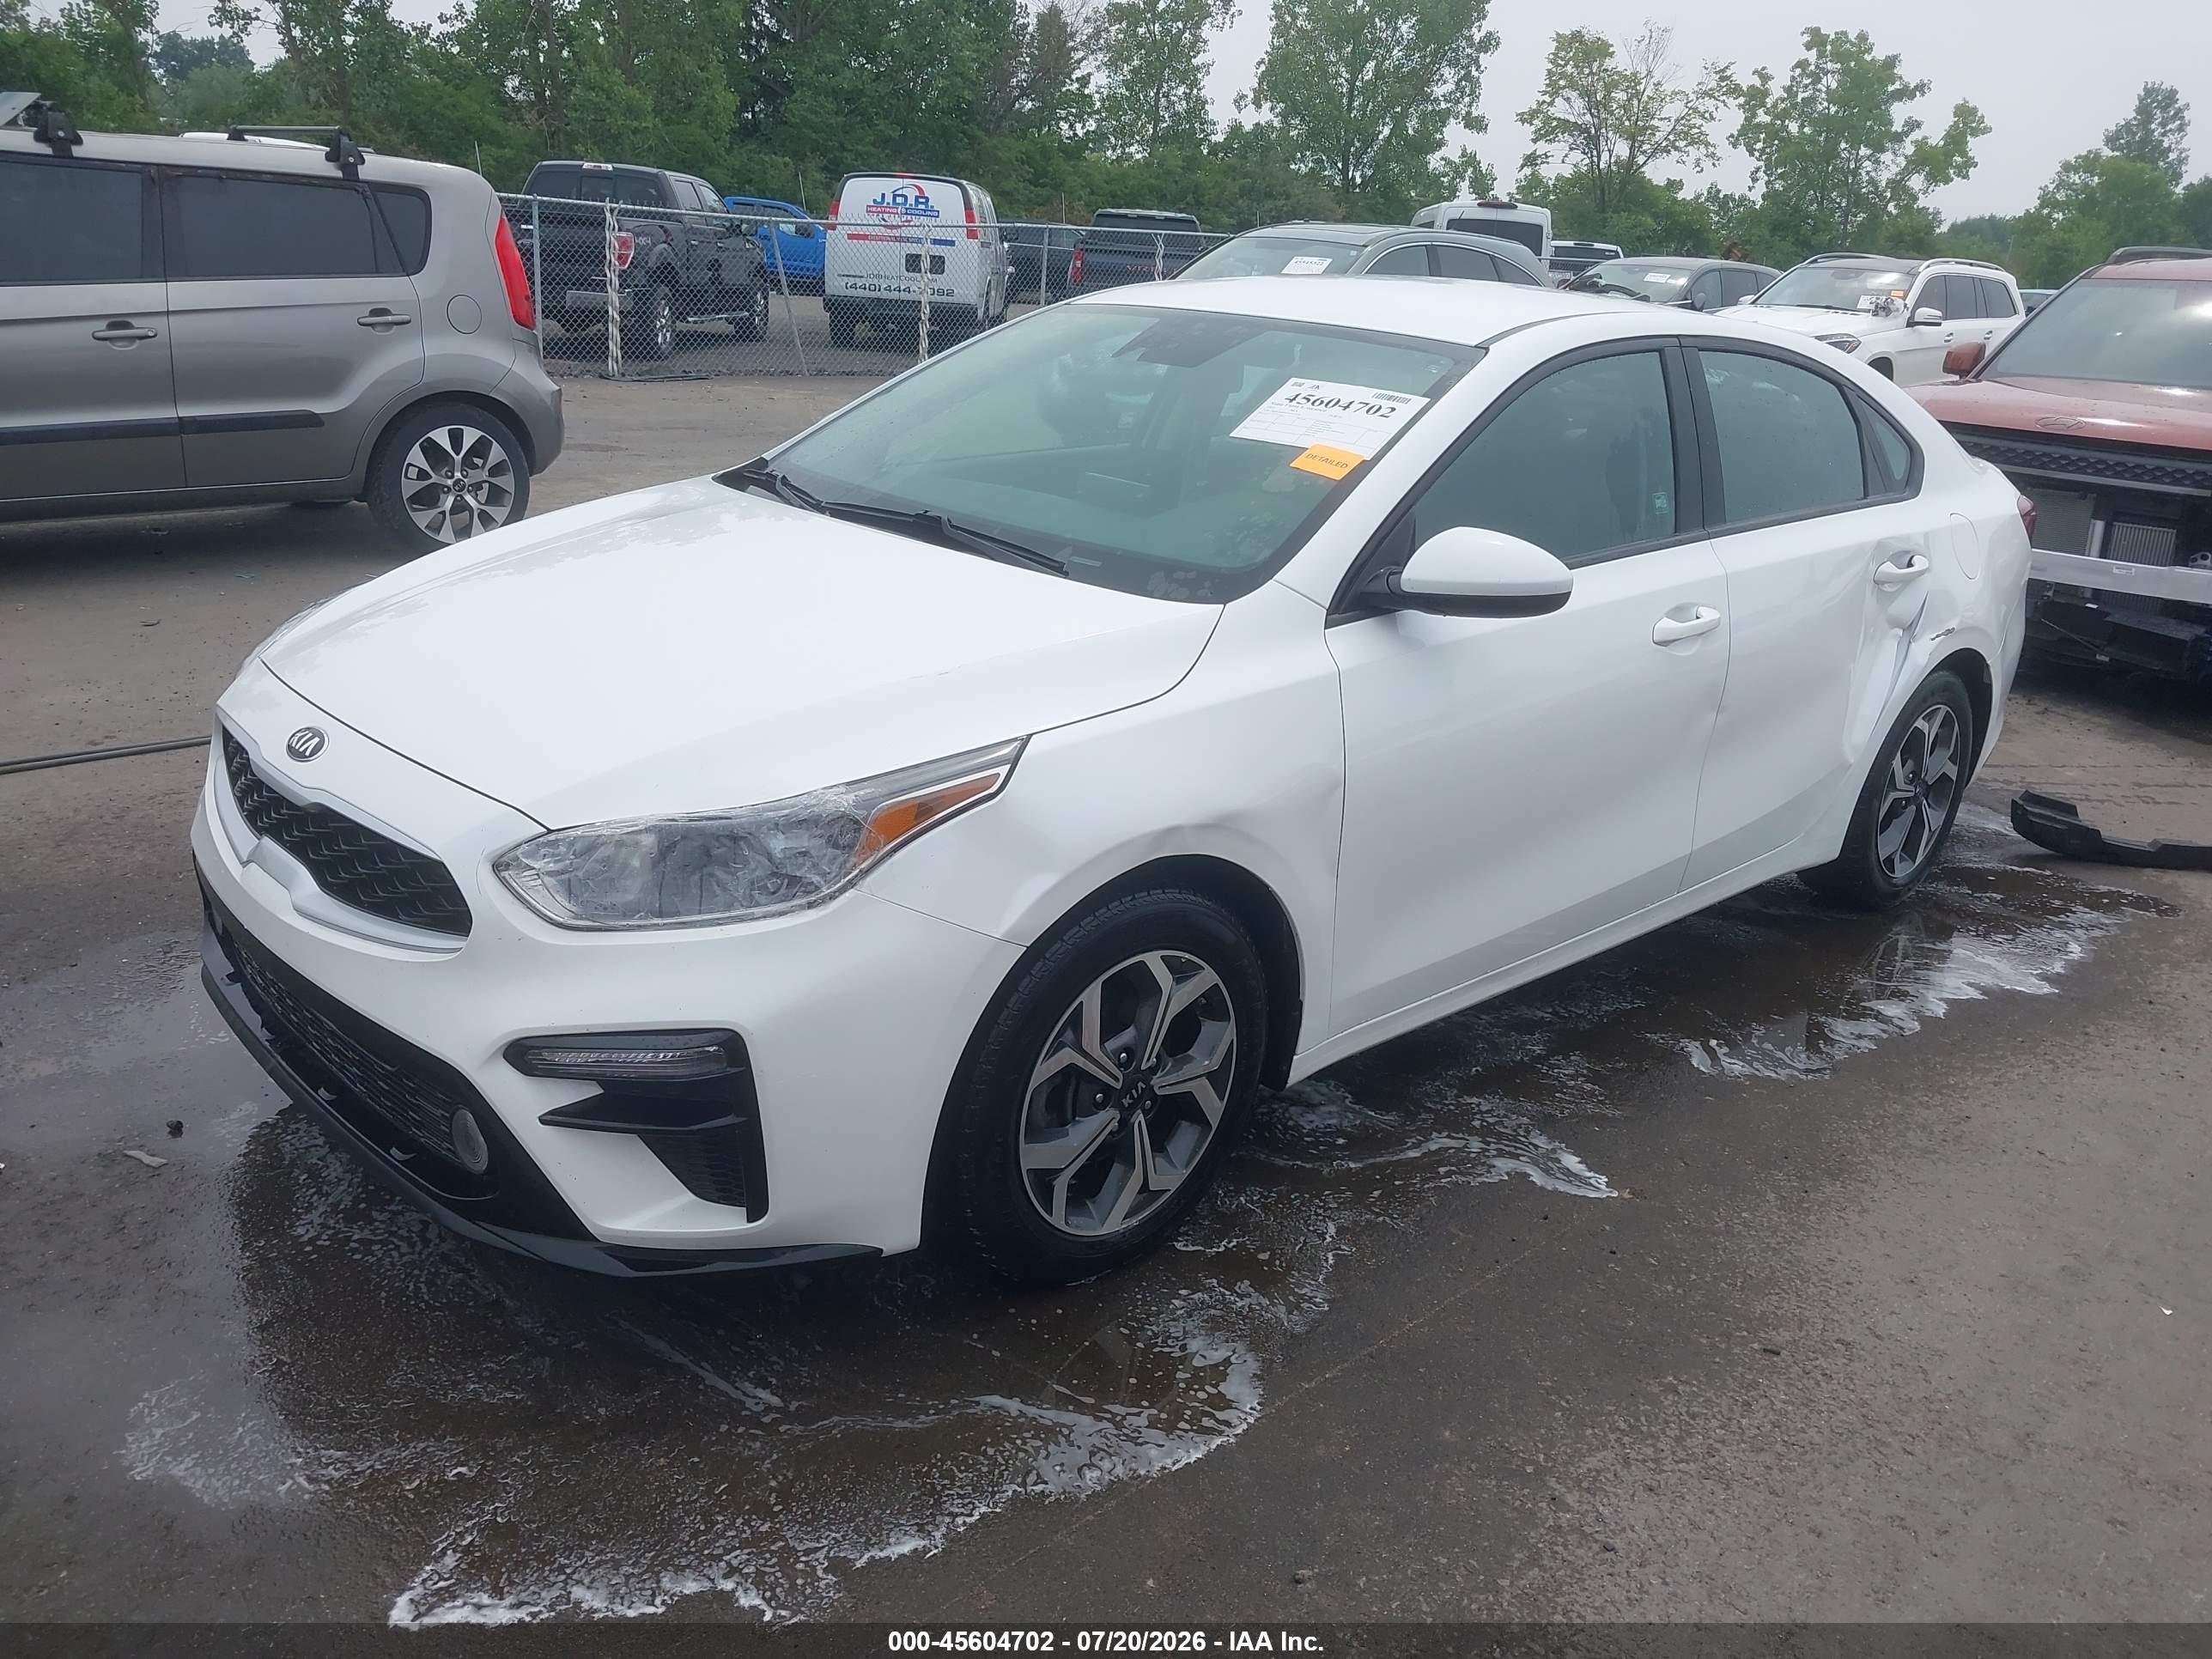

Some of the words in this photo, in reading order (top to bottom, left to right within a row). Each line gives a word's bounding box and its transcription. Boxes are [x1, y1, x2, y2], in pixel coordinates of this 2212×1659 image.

[872, 192, 935, 210] J.D.R.
[845, 282, 881, 292] (440)
[1285, 392, 1397, 419] 45604702
[1304, 452, 1348, 469] DETAILED
[289, 729, 320, 756] KIA
[1121, 1081, 1146, 1107] KIA
